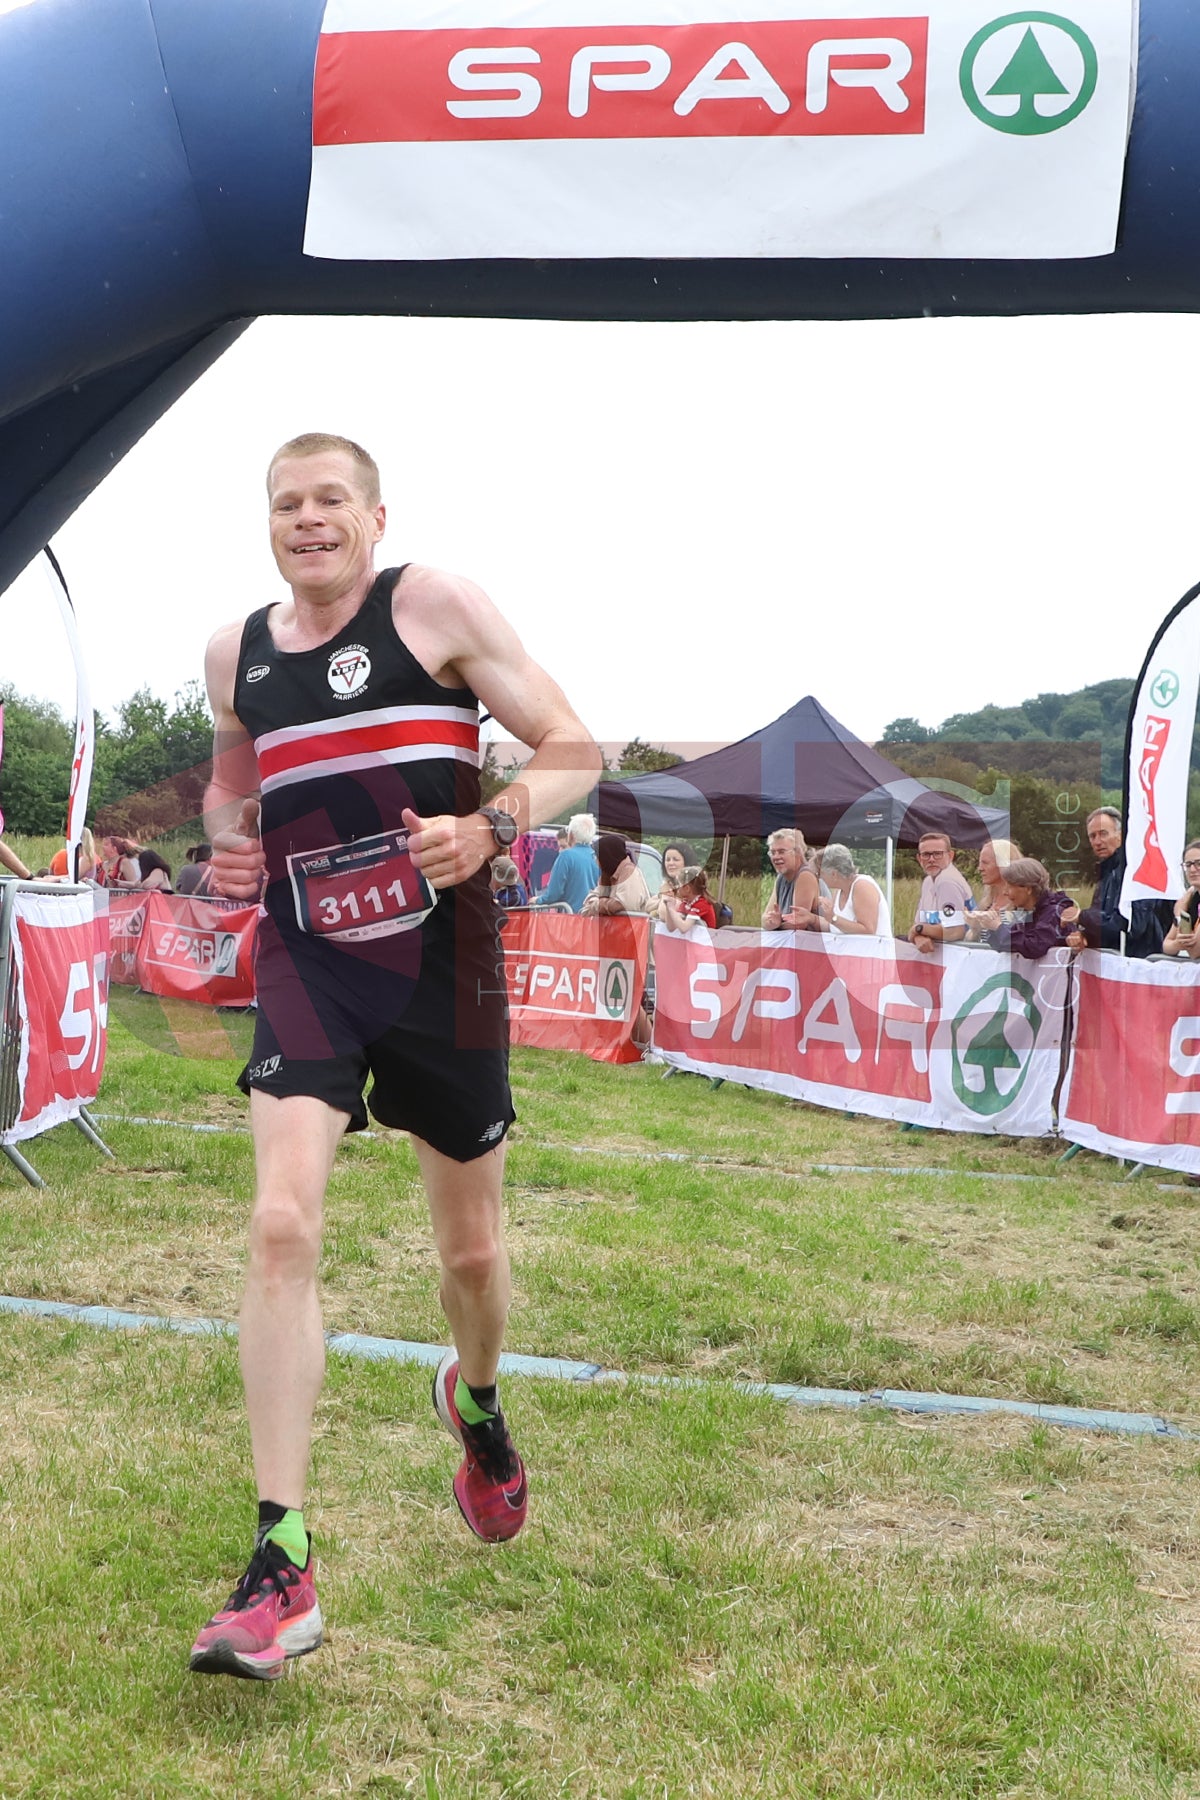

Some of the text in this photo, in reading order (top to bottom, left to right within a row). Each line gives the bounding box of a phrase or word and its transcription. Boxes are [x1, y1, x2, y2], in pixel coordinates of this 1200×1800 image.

[446, 37, 910, 119] SPAR
[328, 643, 370, 663] MANCHESTER
[335, 661, 363, 676] YMCA
[332, 683, 369, 701] HARRIERS
[318, 879, 408, 925] 3111
[156, 931, 215, 965] SPAR
[514, 963, 597, 1004] SPAR
[688, 963, 934, 1074] SPAR
